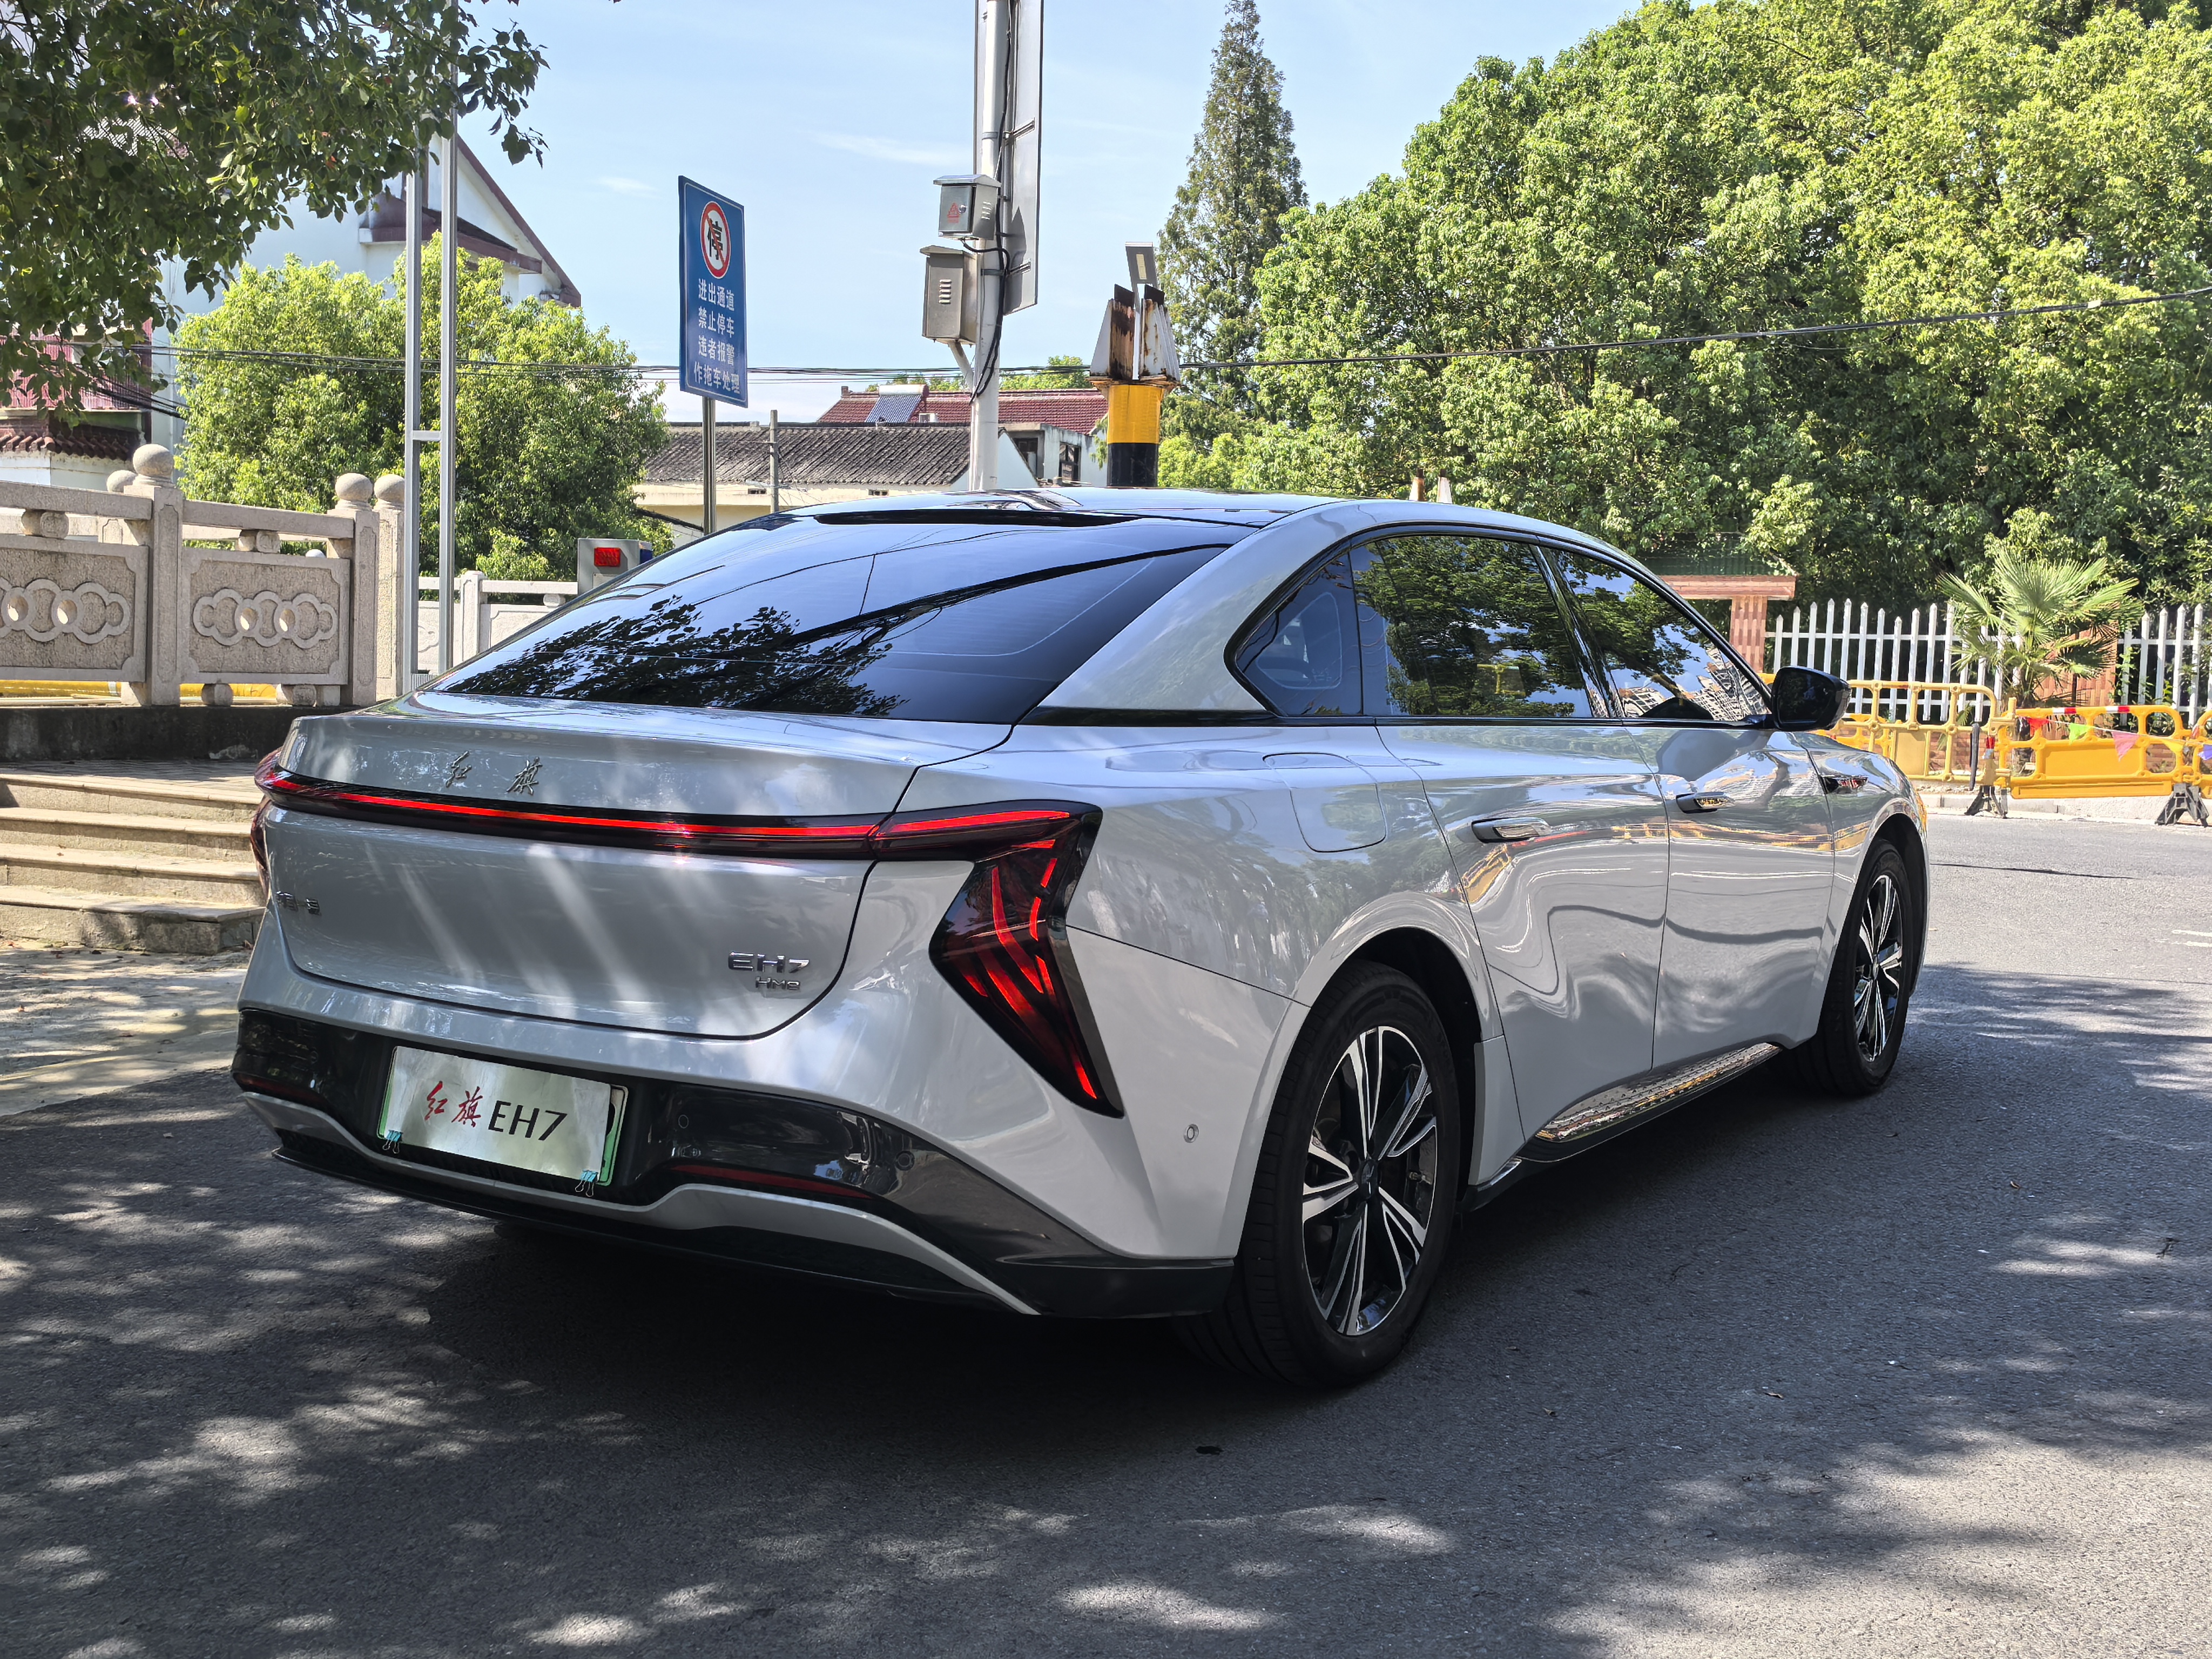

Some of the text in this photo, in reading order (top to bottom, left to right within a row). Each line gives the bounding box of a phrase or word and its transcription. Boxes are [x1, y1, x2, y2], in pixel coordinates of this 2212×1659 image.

[698, 278, 735, 312] 进出通道
[698, 306, 735, 338] 禁止停车
[698, 335, 735, 366] 违者报警
[693, 361, 740, 394] 作拖车处理
[445, 750, 543, 795] 红旗
[728, 952, 810, 973] EH7
[424, 1081, 568, 1141] 红旗 EH7
